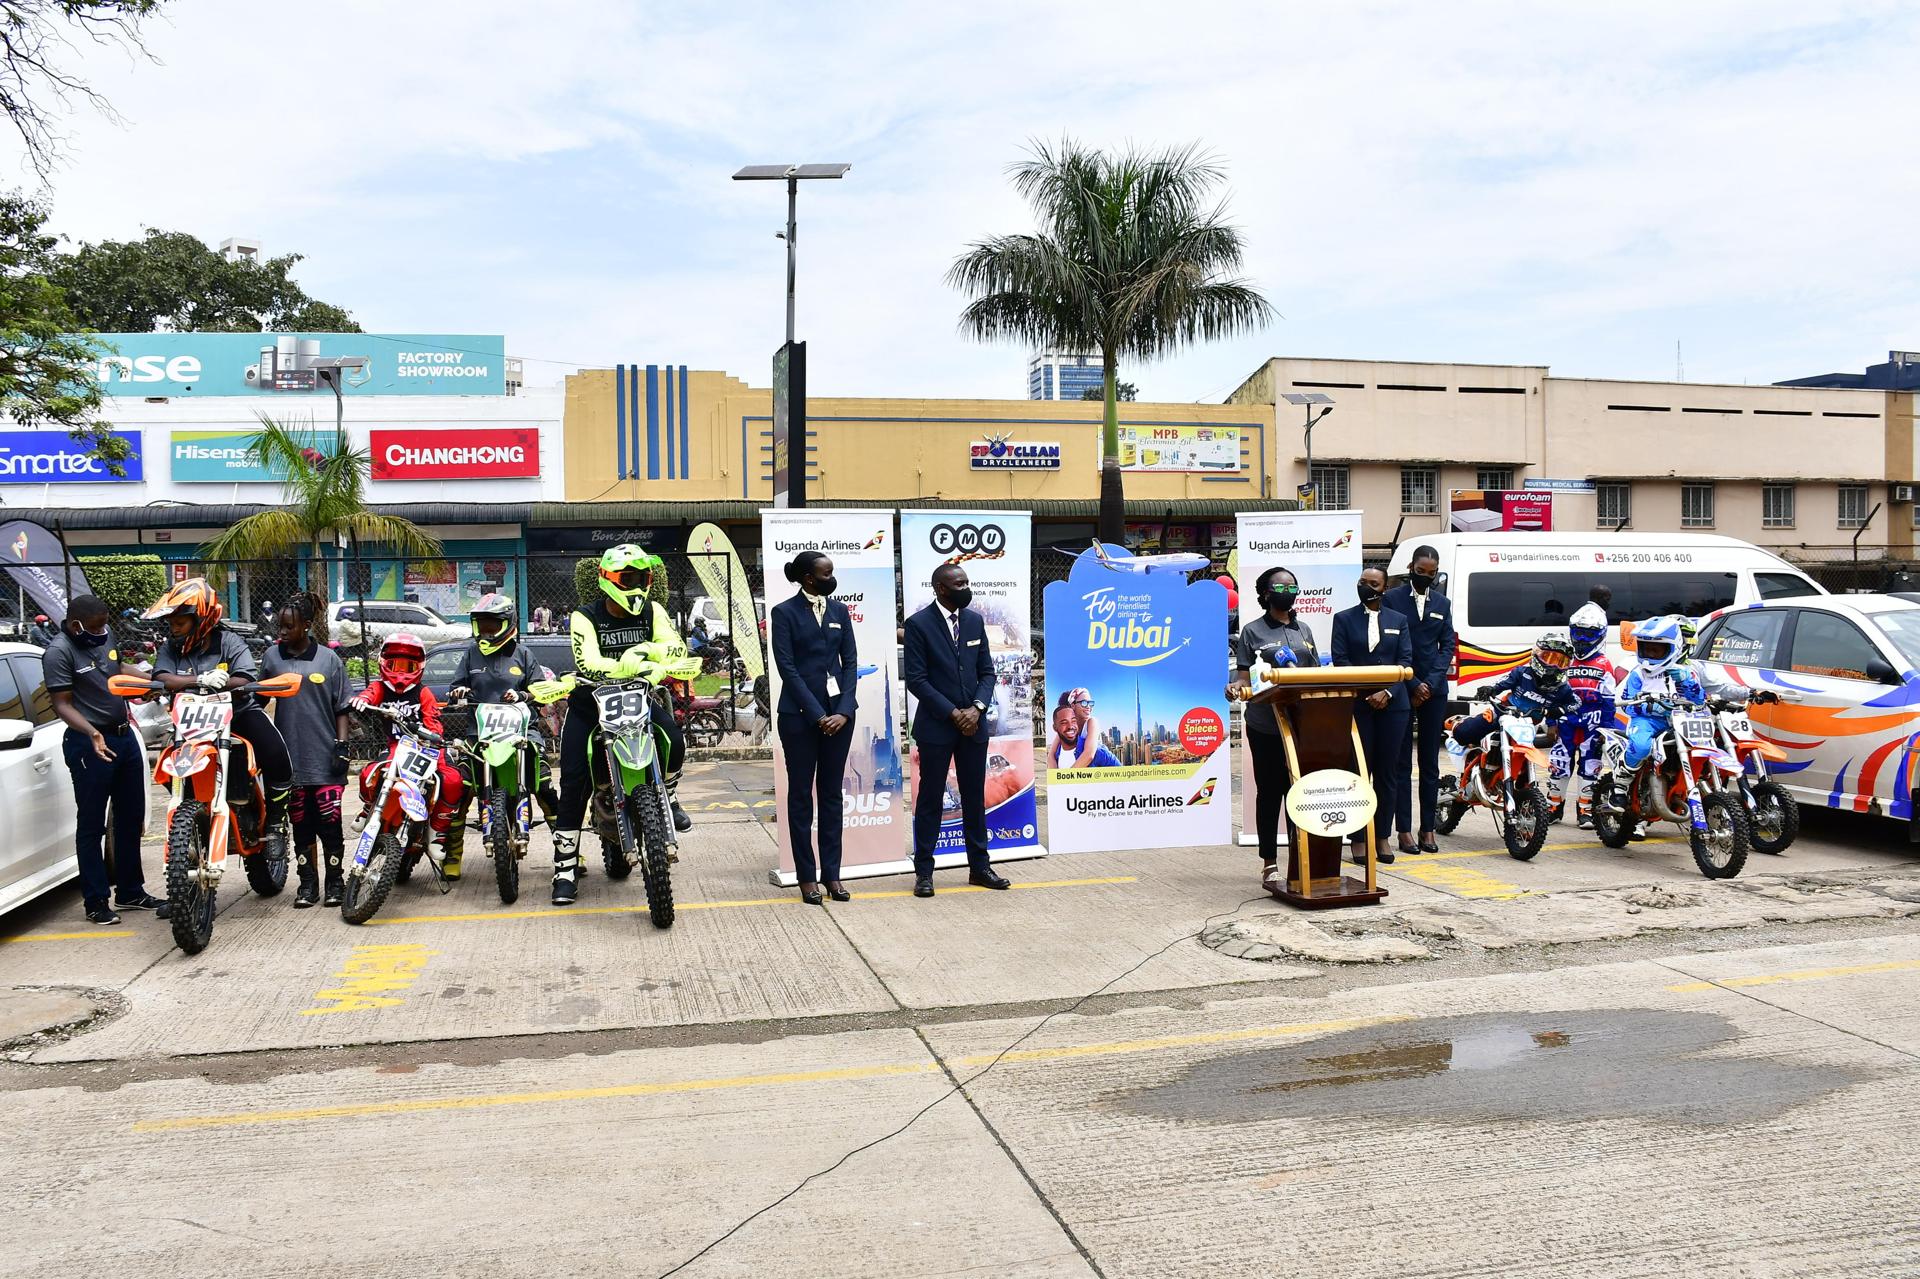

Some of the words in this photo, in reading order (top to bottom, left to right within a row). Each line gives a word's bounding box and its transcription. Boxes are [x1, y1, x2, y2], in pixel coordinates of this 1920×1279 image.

[398, 352, 463, 364] FACTORY
[398, 365, 488, 377] SHOWROOM
[1153, 429, 1179, 439] MPB
[385, 444, 524, 466] CHANGHONG
[1504, 492, 1551, 502] eurofoam
[775, 540, 819, 553] Uganda
[820, 539, 861, 551] Airlines
[1249, 540, 1290, 552] Uganda
[1291, 539, 1330, 549] Airlines
[1500, 552, 1580, 563] Ugandairlines.com
[1606, 553, 1630, 563] +256
[1632, 553, 1651, 563] 200
[1653, 553, 1671, 563] 406
[1674, 553, 1692, 563] 400
[834, 592, 863, 602] world
[1303, 587, 1333, 596] world
[1082, 586, 1116, 622] Fly
[1117, 594, 1129, 602] the
[1129, 594, 1151, 602] world's
[1295, 596, 1327, 605] reater
[1117, 602, 1150, 610] friendliest
[1295, 604, 1333, 615] ectivity
[1138, 611, 1154, 623] to
[1087, 616, 1172, 650] Dubai
[1722, 639, 1751, 651] N.Yasin
[1752, 640, 1764, 650] B+
[1749, 653, 1760, 663] B+
[1566, 667, 1604, 679] EROME
[605, 692, 643, 721] 99
[180, 706, 223, 730] 444
[485, 713, 521, 733] 444
[1184, 723, 1218, 735] 3pieces
[1680, 720, 1714, 738] 199
[1730, 720, 1749, 732] 28
[401, 751, 432, 777] 19
[1056, 772, 1075, 780] Book
[1076, 771, 1093, 779] Now
[1103, 767, 1187, 779] www.ugandairlines.com
[842, 788, 891, 815] bus
[1066, 795, 1125, 814] Uganda
[1128, 794, 1184, 808] Airlines
[947, 829, 963, 838] SPO
[950, 837, 966, 847] FIR
